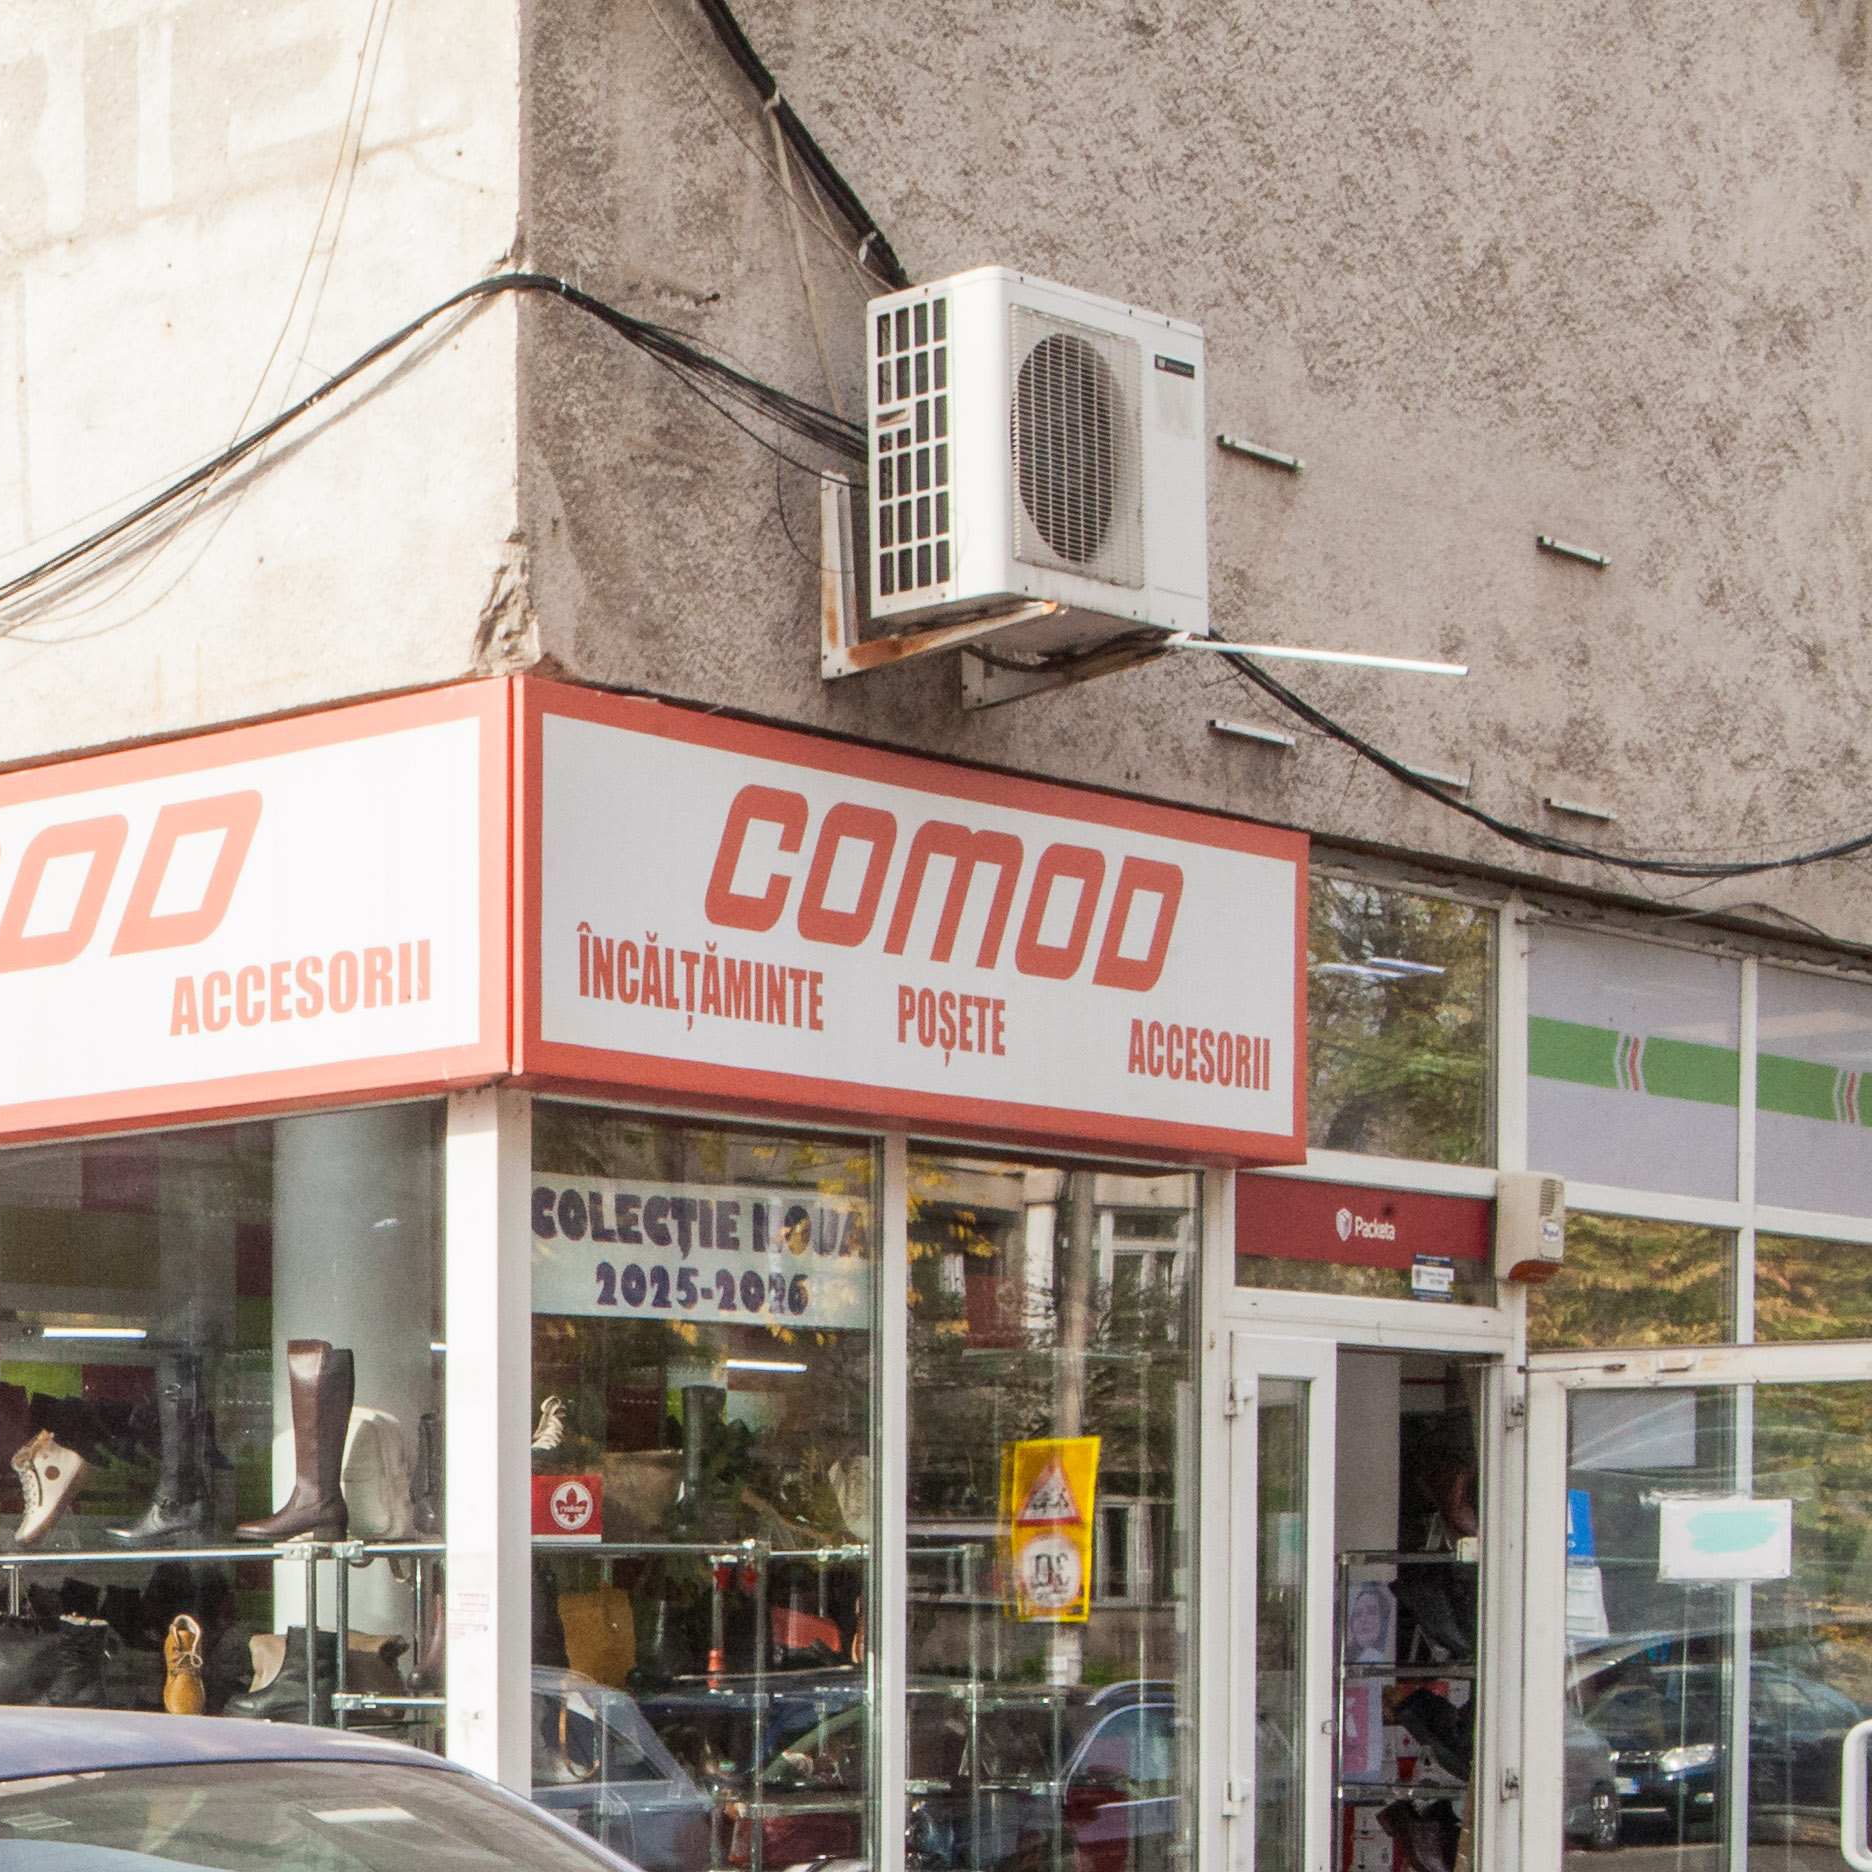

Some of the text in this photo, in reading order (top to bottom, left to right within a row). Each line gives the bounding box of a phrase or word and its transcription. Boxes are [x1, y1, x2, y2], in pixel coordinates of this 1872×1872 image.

[704, 784, 1184, 992] COMOD
[168, 939, 432, 1037] ACCESORII
[576, 921, 1271, 1092] ÎNCĂLȚĂMINTE POȘETE ACCESORII
[1354, 1215, 1396, 1242] Packeta
[595, 1260, 810, 1317] 2025-2026
